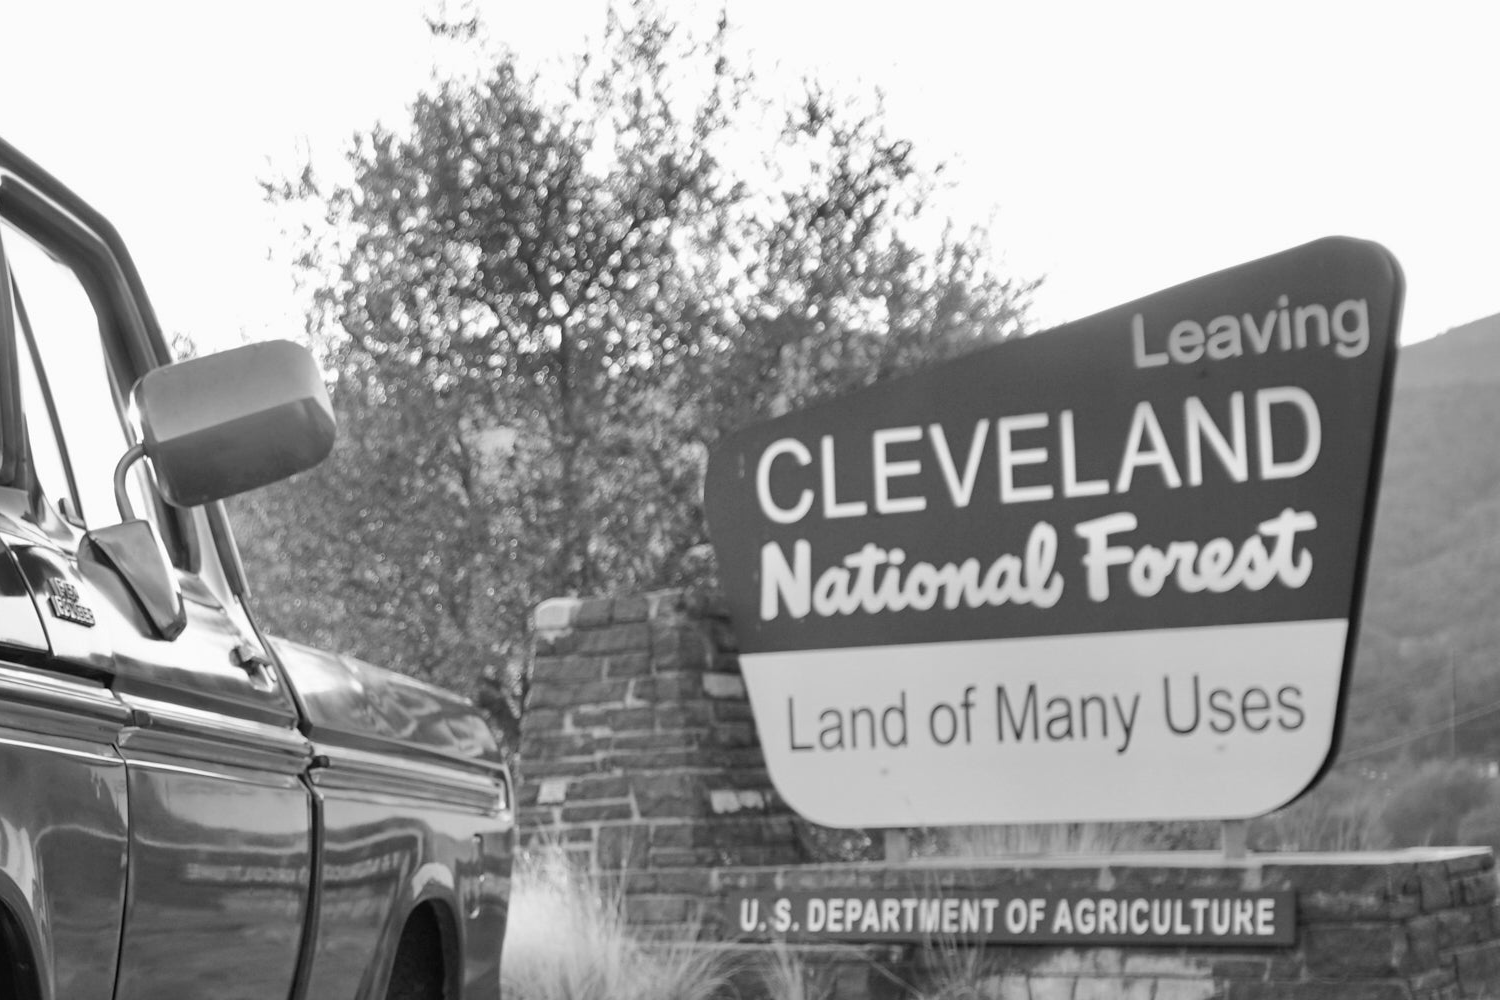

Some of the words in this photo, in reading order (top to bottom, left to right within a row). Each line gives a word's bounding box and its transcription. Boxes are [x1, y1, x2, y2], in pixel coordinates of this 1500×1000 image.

[1132, 294, 1370, 370] Leaving
[755, 385, 1322, 524] CLEVELAND
[759, 521, 1064, 621] National
[1074, 508, 1317, 602] Forest
[786, 690, 909, 752] Land
[928, 685, 978, 746] of
[996, 682, 1141, 754] Many
[1163, 674, 1306, 736] Uses
[806, 898, 1000, 935] DEPARTMENT
[1005, 898, 1047, 935] OF
[1052, 898, 1276, 937] AGRICULTURE
